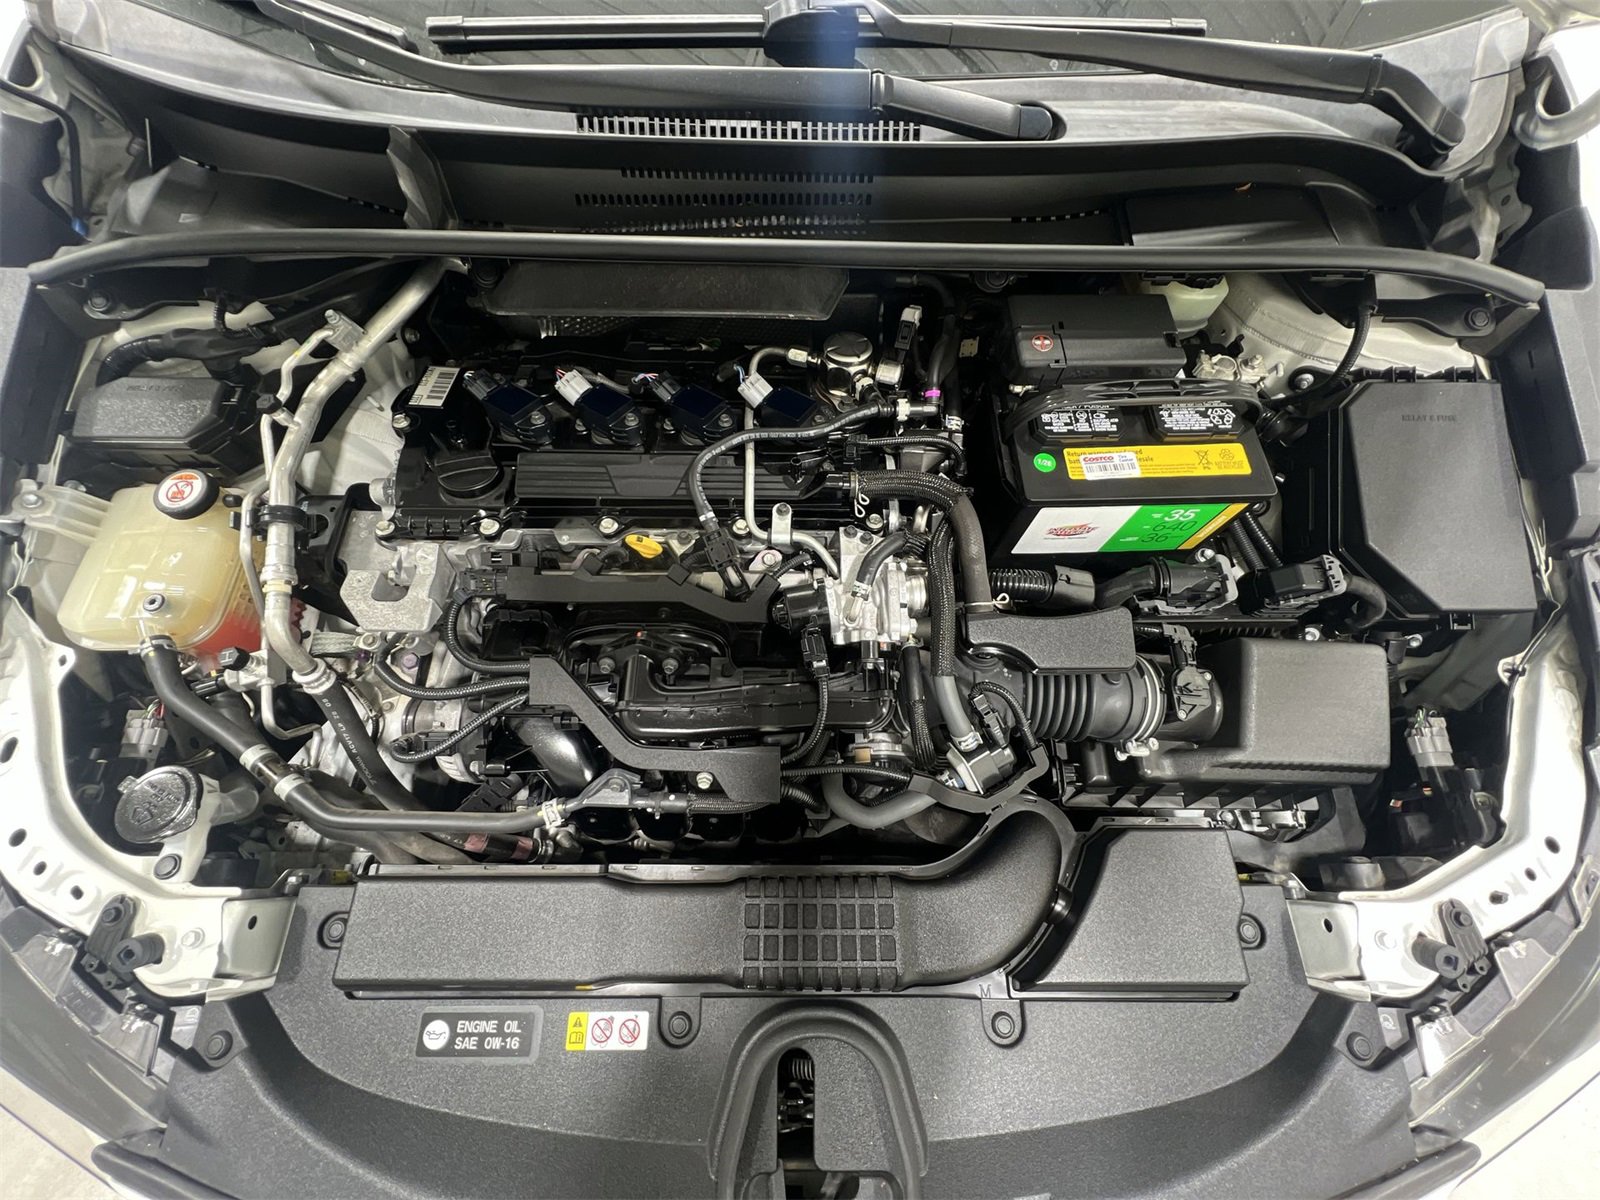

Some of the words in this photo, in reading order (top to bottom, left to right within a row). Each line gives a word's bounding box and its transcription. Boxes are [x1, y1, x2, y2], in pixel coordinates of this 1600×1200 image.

[1083, 455, 1114, 463] COSTCO
[1164, 509, 1201, 521] 35
[1152, 520, 1197, 532] 640
[1141, 533, 1170, 543] 36
[457, 1020, 497, 1033] ENGINE
[504, 1020, 522, 1033] OIL
[454, 1037, 478, 1050] SAE
[484, 1037, 520, 1050] 0W-16
